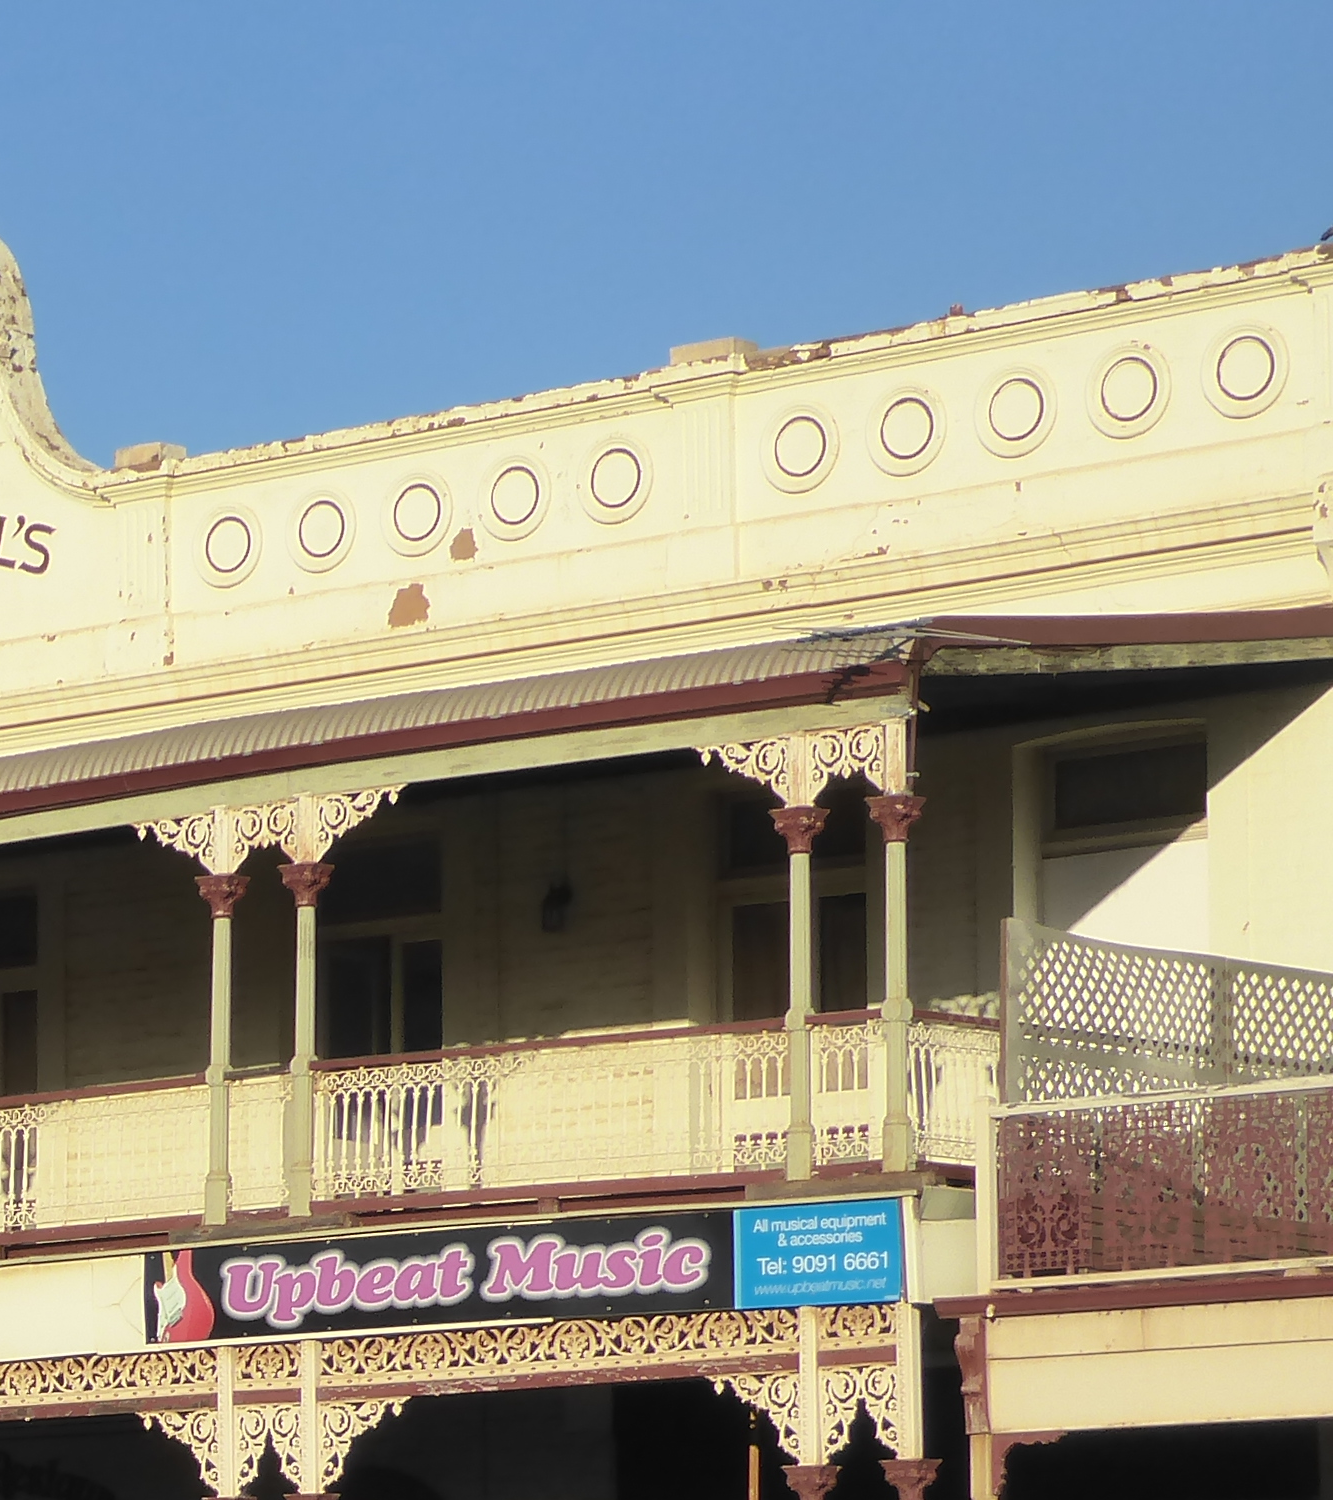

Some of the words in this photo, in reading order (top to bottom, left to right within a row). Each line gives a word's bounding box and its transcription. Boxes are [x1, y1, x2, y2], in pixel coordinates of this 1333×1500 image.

[752, 1219, 769, 1233] All
[771, 1216, 818, 1233] musical
[820, 1212, 887, 1231] equipment
[777, 1232, 788, 1247] &
[789, 1230, 864, 1247] accessories
[756, 1257, 788, 1276] Tel:
[792, 1253, 837, 1274] 9091
[843, 1251, 889, 1271] 6661
[223, 1247, 471, 1324] Upbeat
[484, 1232, 707, 1296] Music
[754, 1276, 887, 1296] www.upbeatmusic.net
